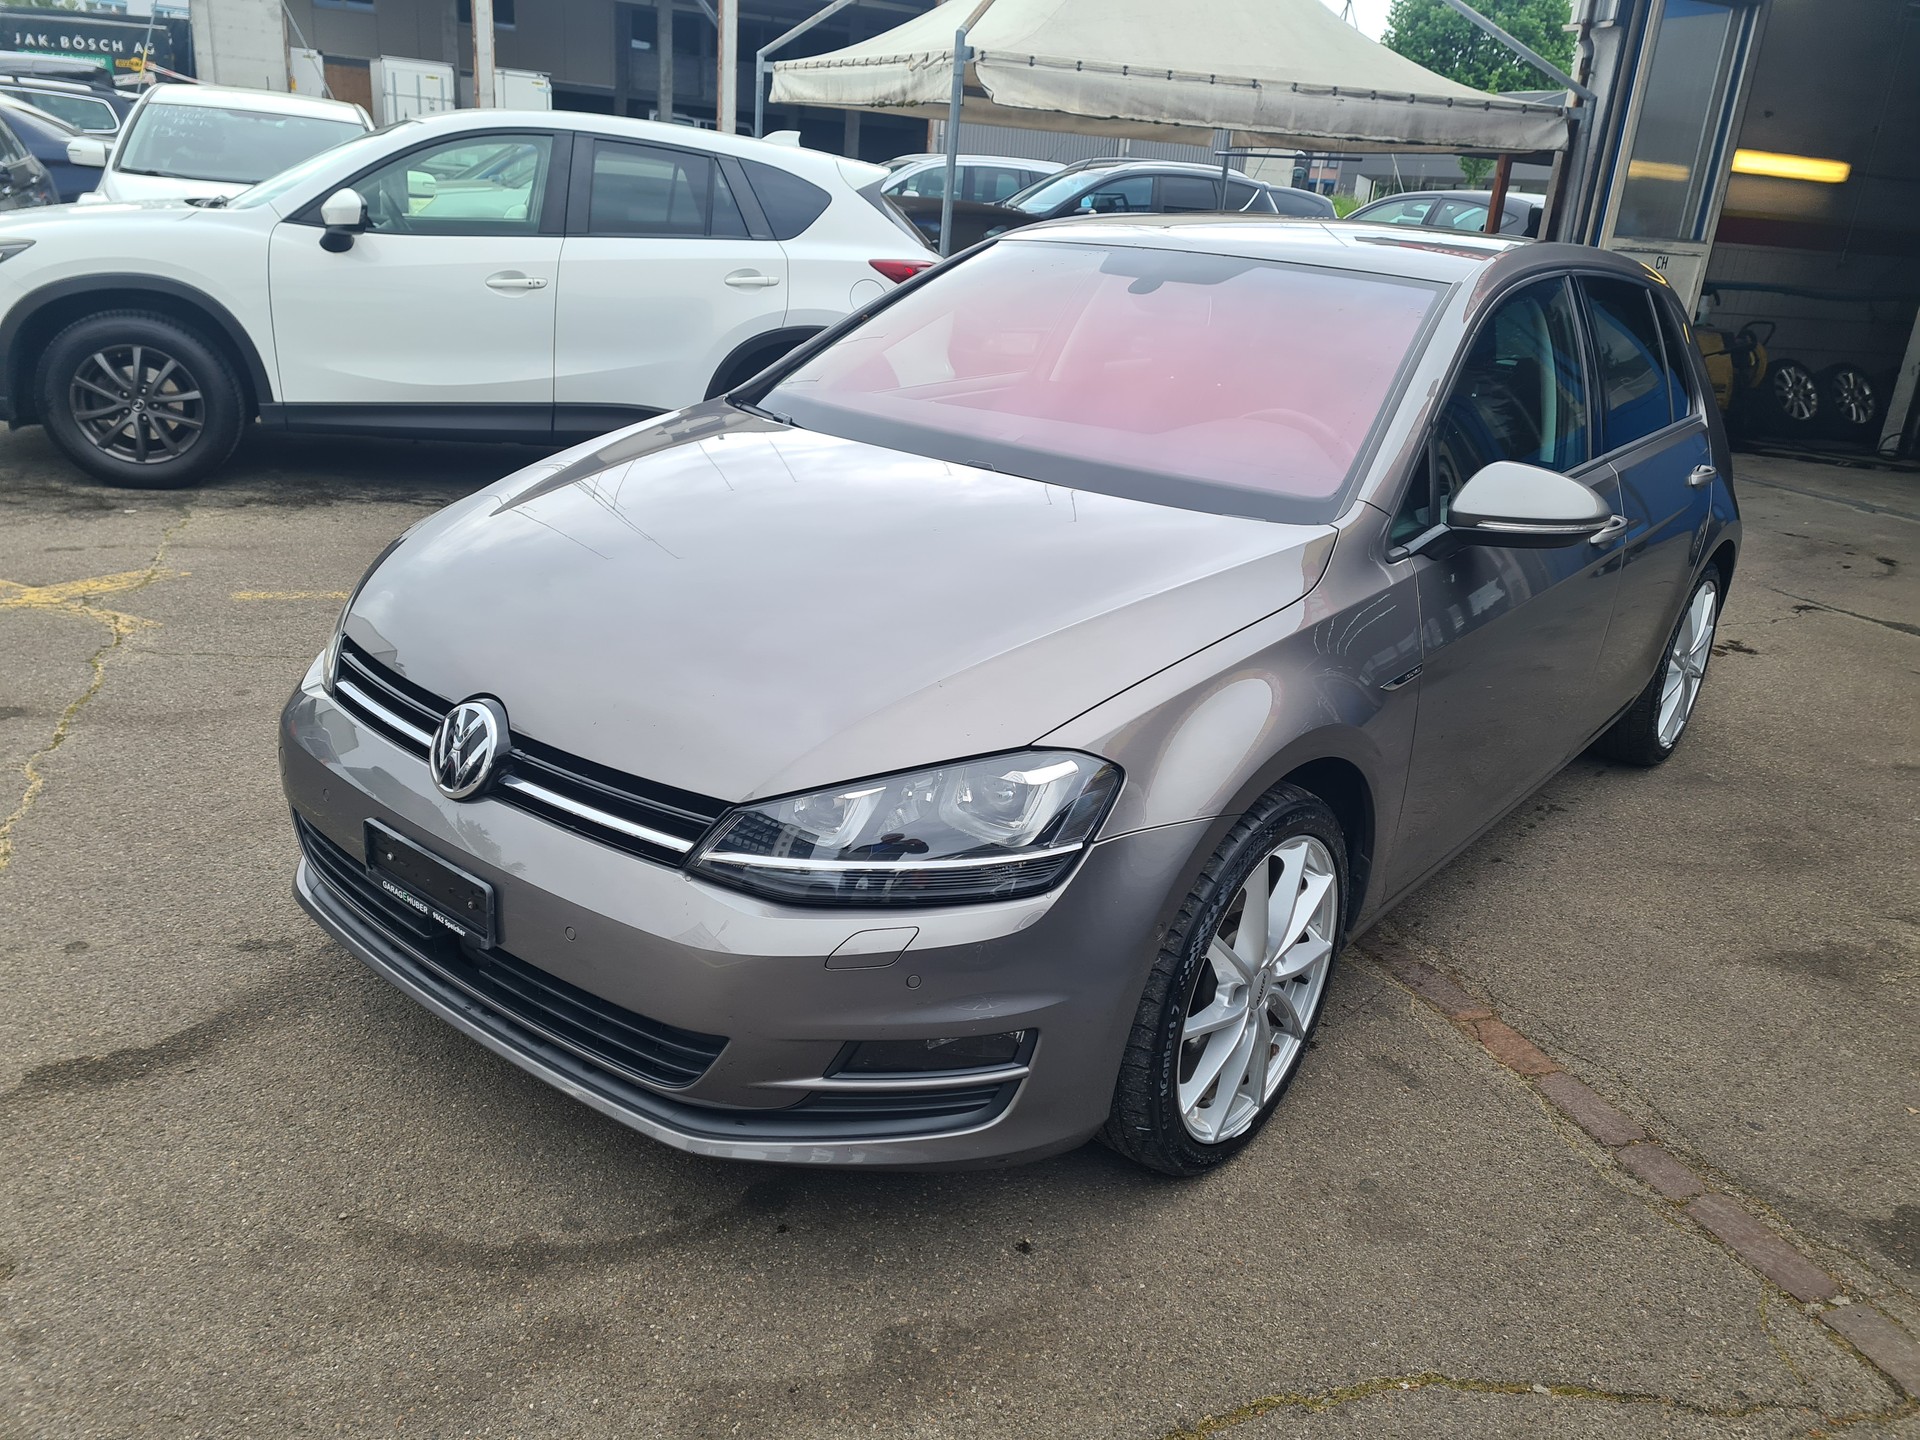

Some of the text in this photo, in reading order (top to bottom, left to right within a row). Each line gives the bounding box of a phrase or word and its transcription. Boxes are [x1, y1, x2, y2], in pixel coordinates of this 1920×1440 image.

[14, 32, 156, 55] JAK. BÖSCH AG
[1656, 255, 1669, 270] CH
